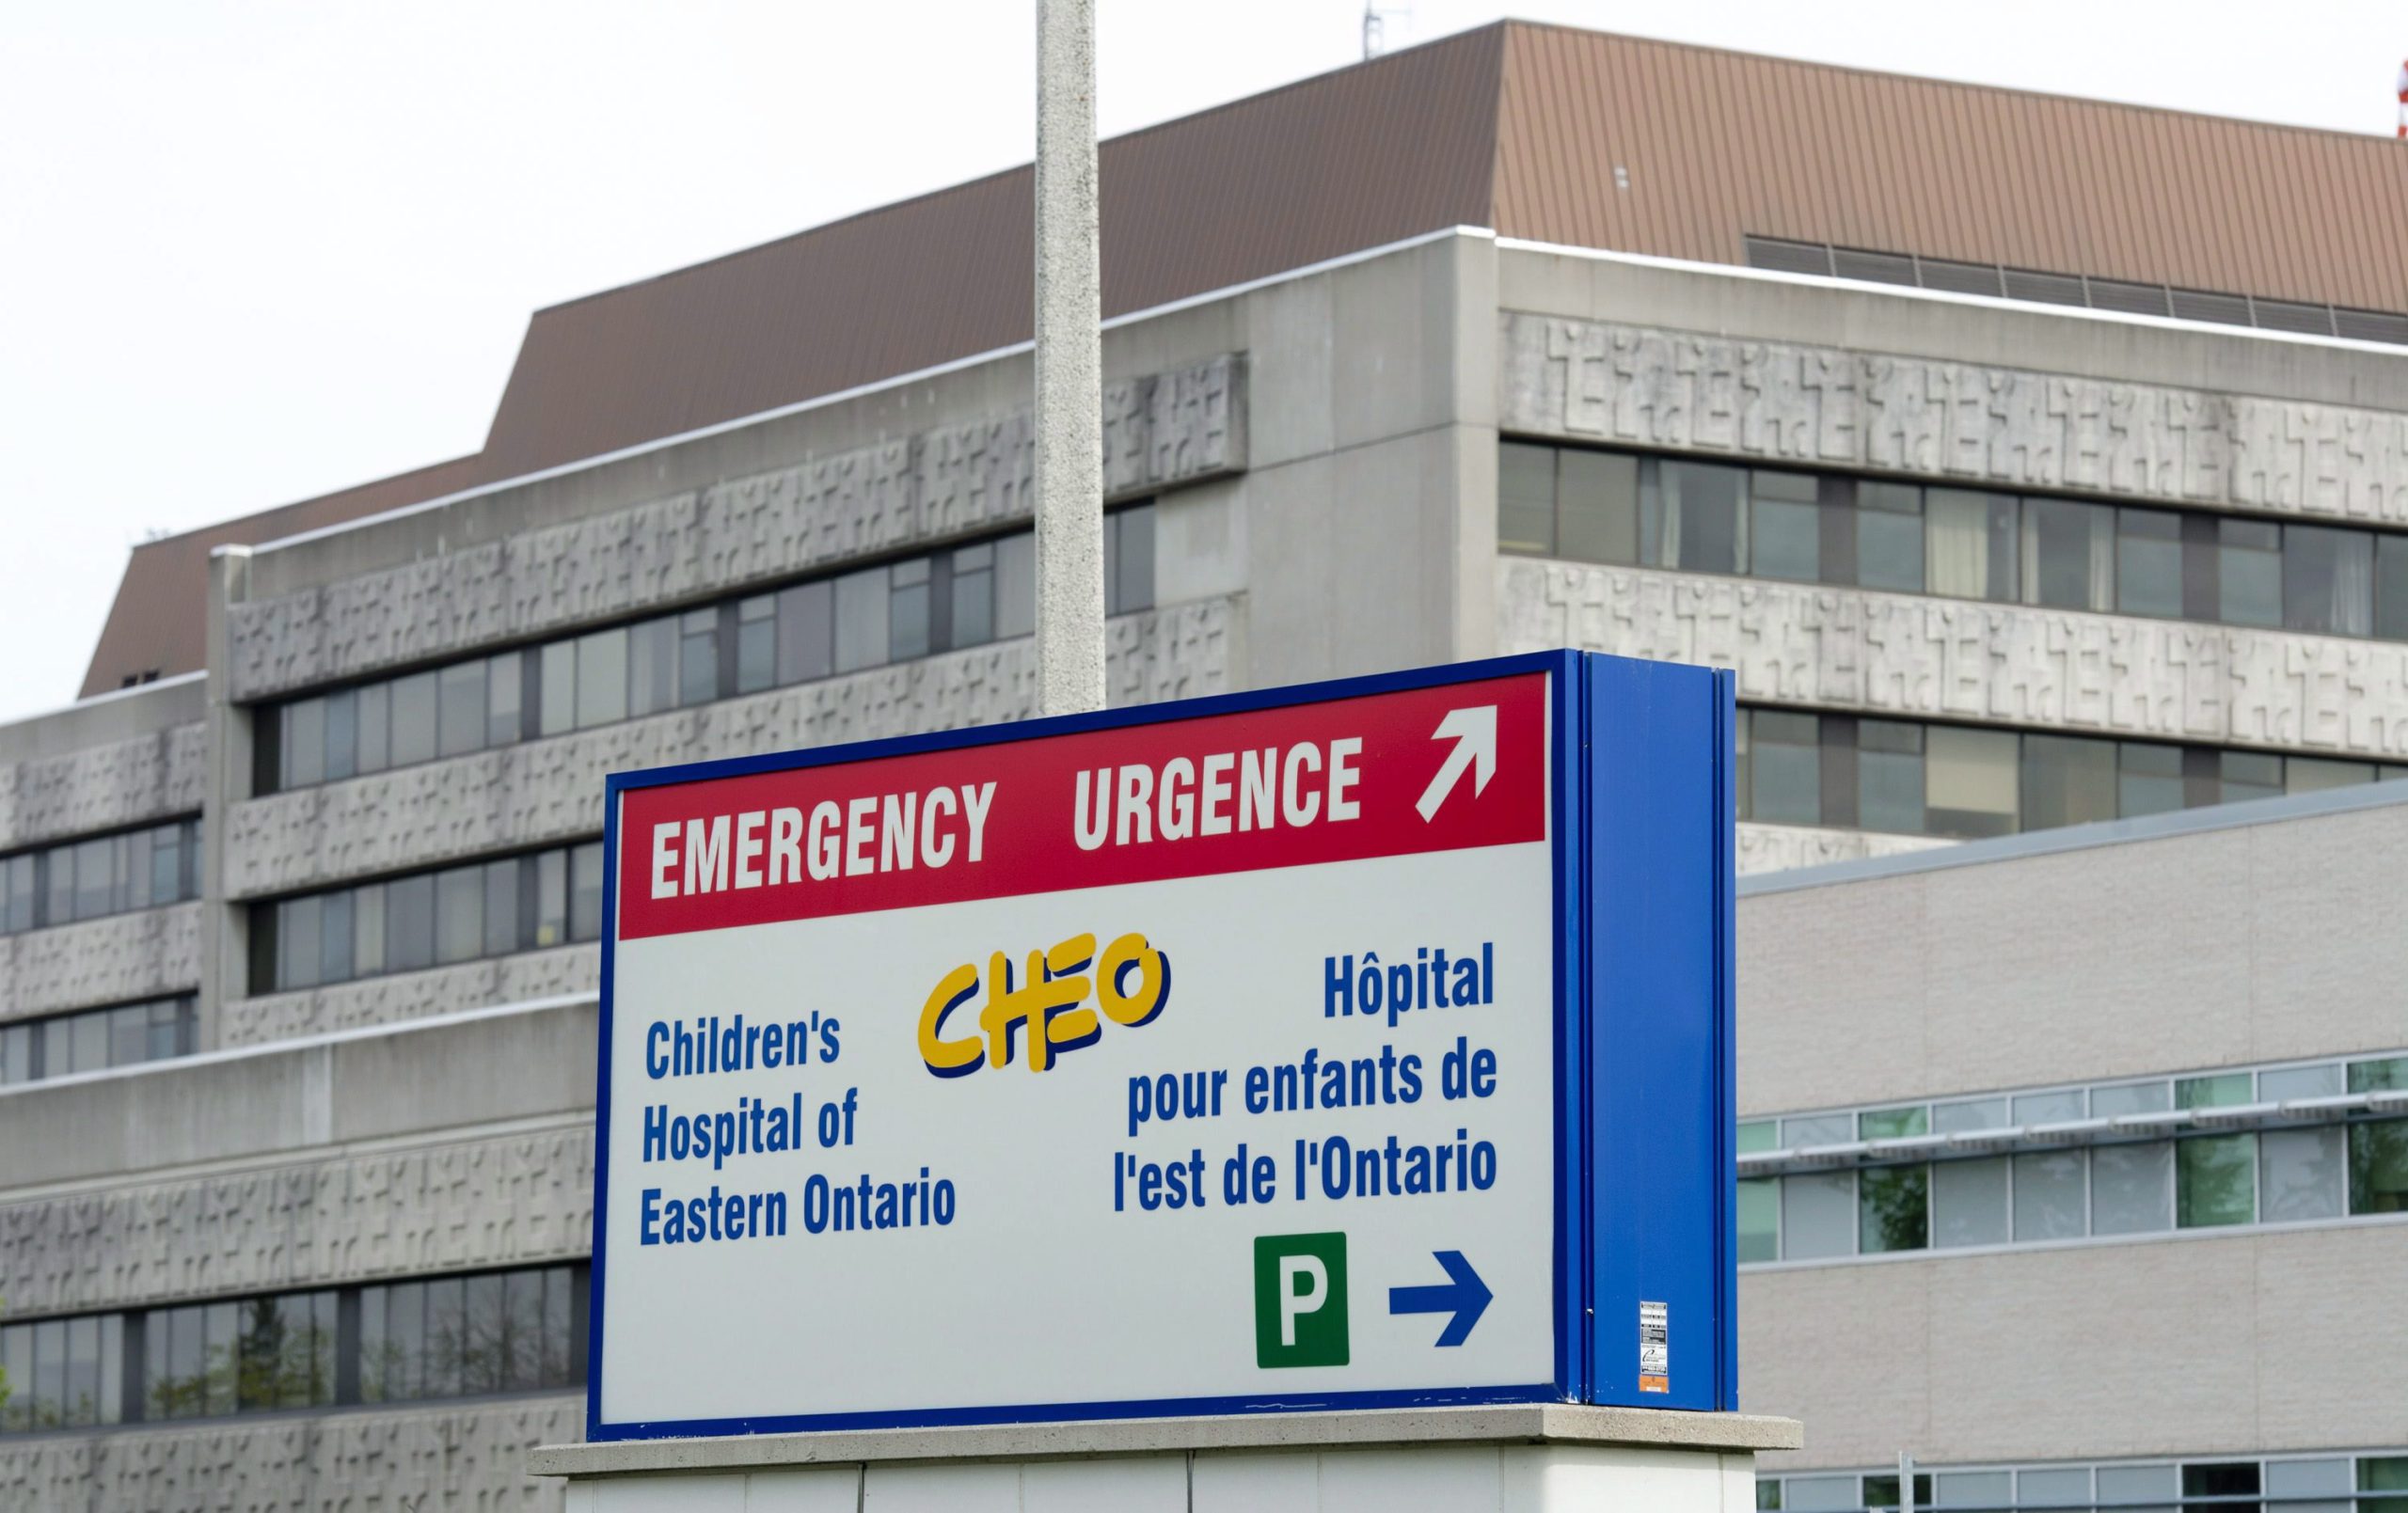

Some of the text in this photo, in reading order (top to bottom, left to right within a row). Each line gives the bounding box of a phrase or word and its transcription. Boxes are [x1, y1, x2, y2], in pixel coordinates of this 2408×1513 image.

[651, 737, 1362, 900] EMERGENCY URGENCE
[918, 933, 1170, 1079] CHEO
[1325, 942, 1493, 1027] Hôpital
[647, 1011, 839, 1080] Children's
[1129, 1036, 1497, 1137] pour enfants de
[643, 1087, 857, 1170] Hospital of
[1115, 1128, 1496, 1211] l'est de l'Ontario
[641, 1167, 955, 1245] Eastern Ontario
[1280, 1255, 1327, 1345] P
